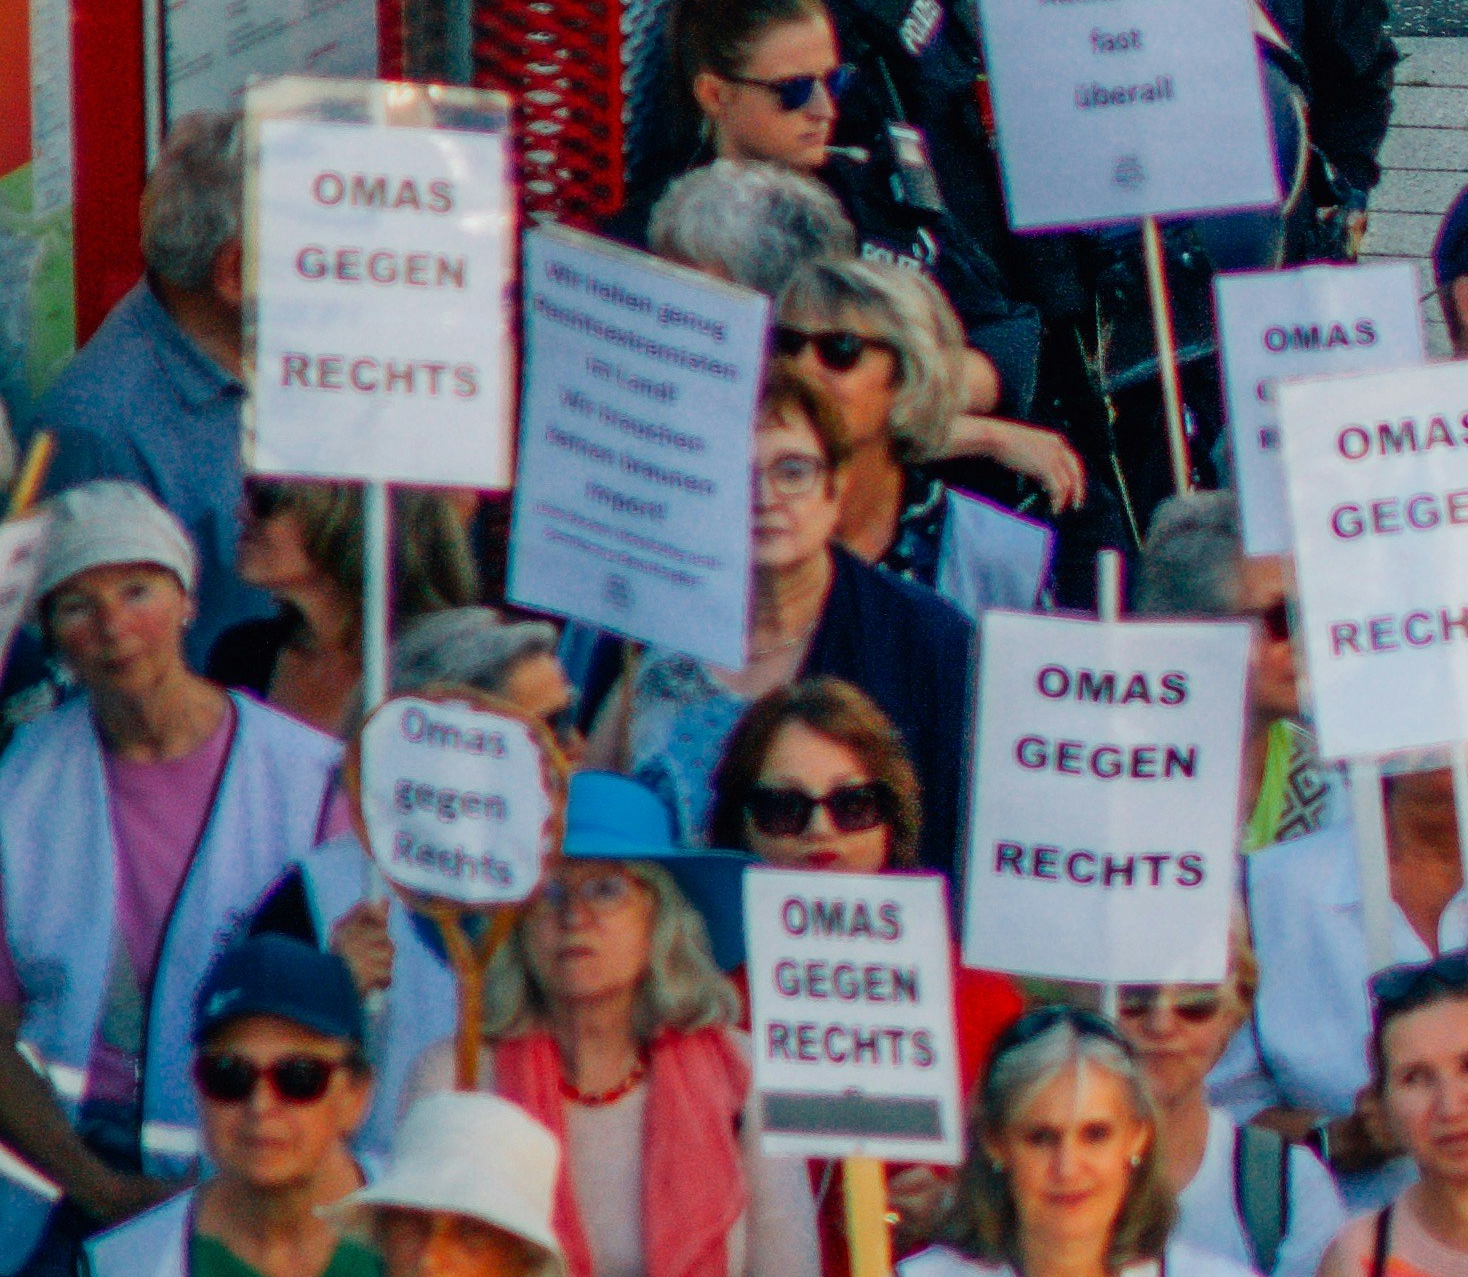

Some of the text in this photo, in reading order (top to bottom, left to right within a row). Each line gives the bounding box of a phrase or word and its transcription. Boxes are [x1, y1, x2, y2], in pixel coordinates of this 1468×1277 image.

[1091, 27, 1142, 53] fast
[1074, 75, 1174, 110] überall
[310, 169, 457, 214] OMAS
[293, 243, 468, 291] GEGEN
[1262, 319, 1378, 354] OMAS
[278, 350, 481, 401] RECHTS
[1036, 663, 1191, 707] OMAS
[402, 705, 509, 761] Omas
[1015, 734, 1198, 781] GEGEN
[393, 773, 508, 825] gegen
[389, 833, 514, 887] Rechts
[993, 839, 1206, 889] RECHTS
[780, 898, 904, 943] OMAS
[773, 960, 920, 1005] GEGEN
[765, 1021, 935, 1068] RECHTS
